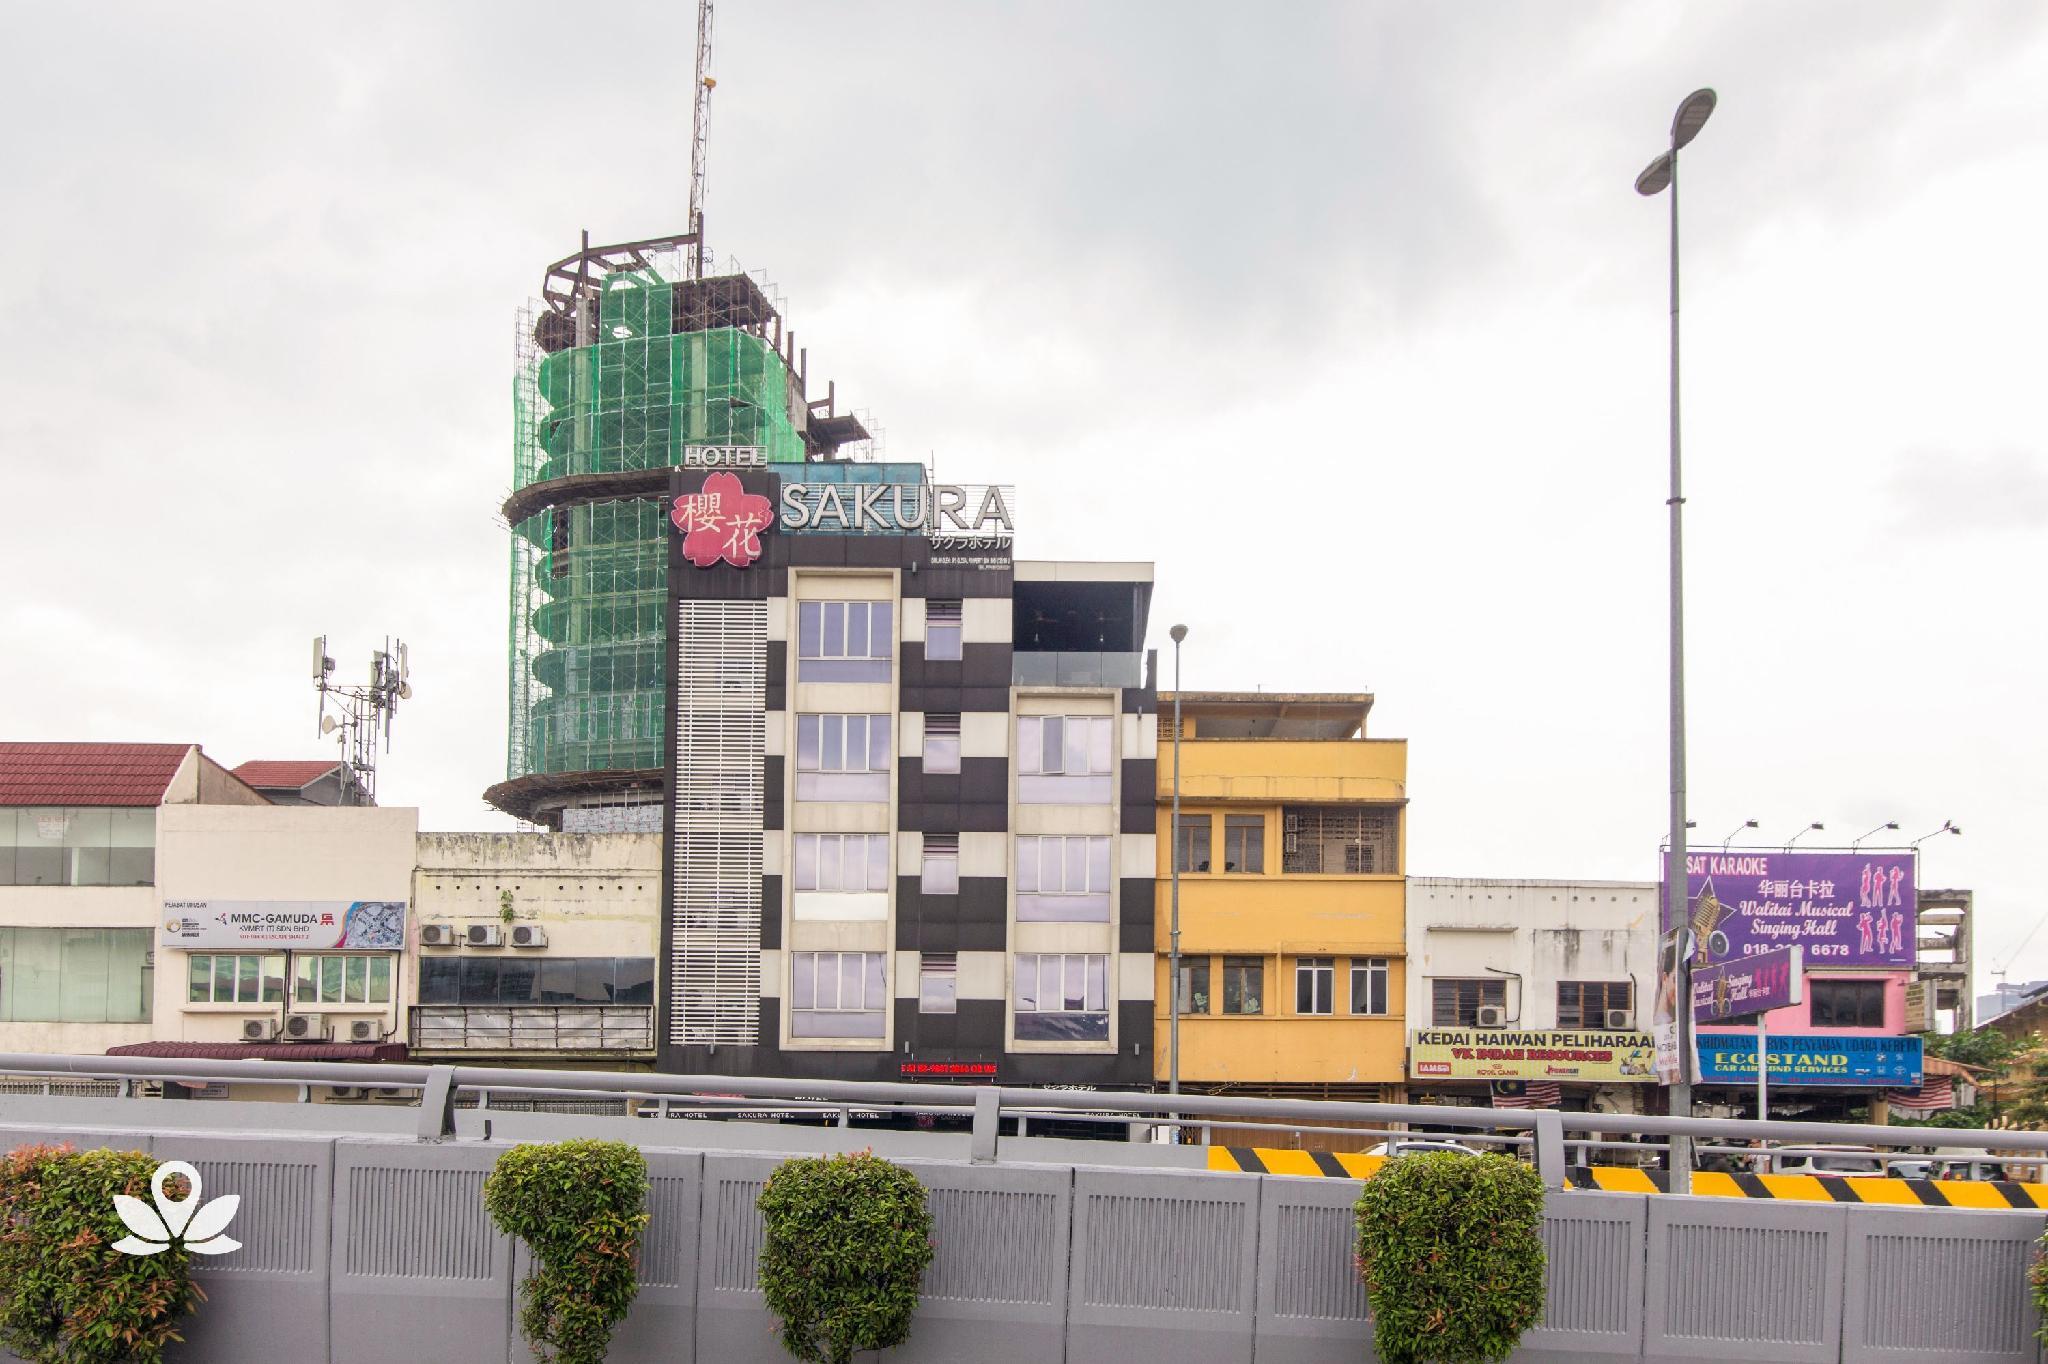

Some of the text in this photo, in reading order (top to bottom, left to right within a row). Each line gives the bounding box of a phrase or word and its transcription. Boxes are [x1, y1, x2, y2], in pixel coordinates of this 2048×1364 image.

[684, 446, 767, 466] HOTEL
[781, 483, 1014, 530] SAKURA
[929, 535, 1011, 550] サクラホテル
[1686, 856, 1768, 875] SAT KARAOKE
[1739, 901, 1854, 918] Walitai Musical
[231, 913, 318, 924] MMC-GAMUDA
[1751, 919, 1838, 939] Singing Hall
[1811, 945, 1850, 956] 6678
[1418, 1032, 1470, 1045] KEDAI
[1475, 1033, 1547, 1046] HAIWAN
[1477, 1048, 1524, 1061] INDAH
[1527, 1049, 1613, 1062] RESOURCES
